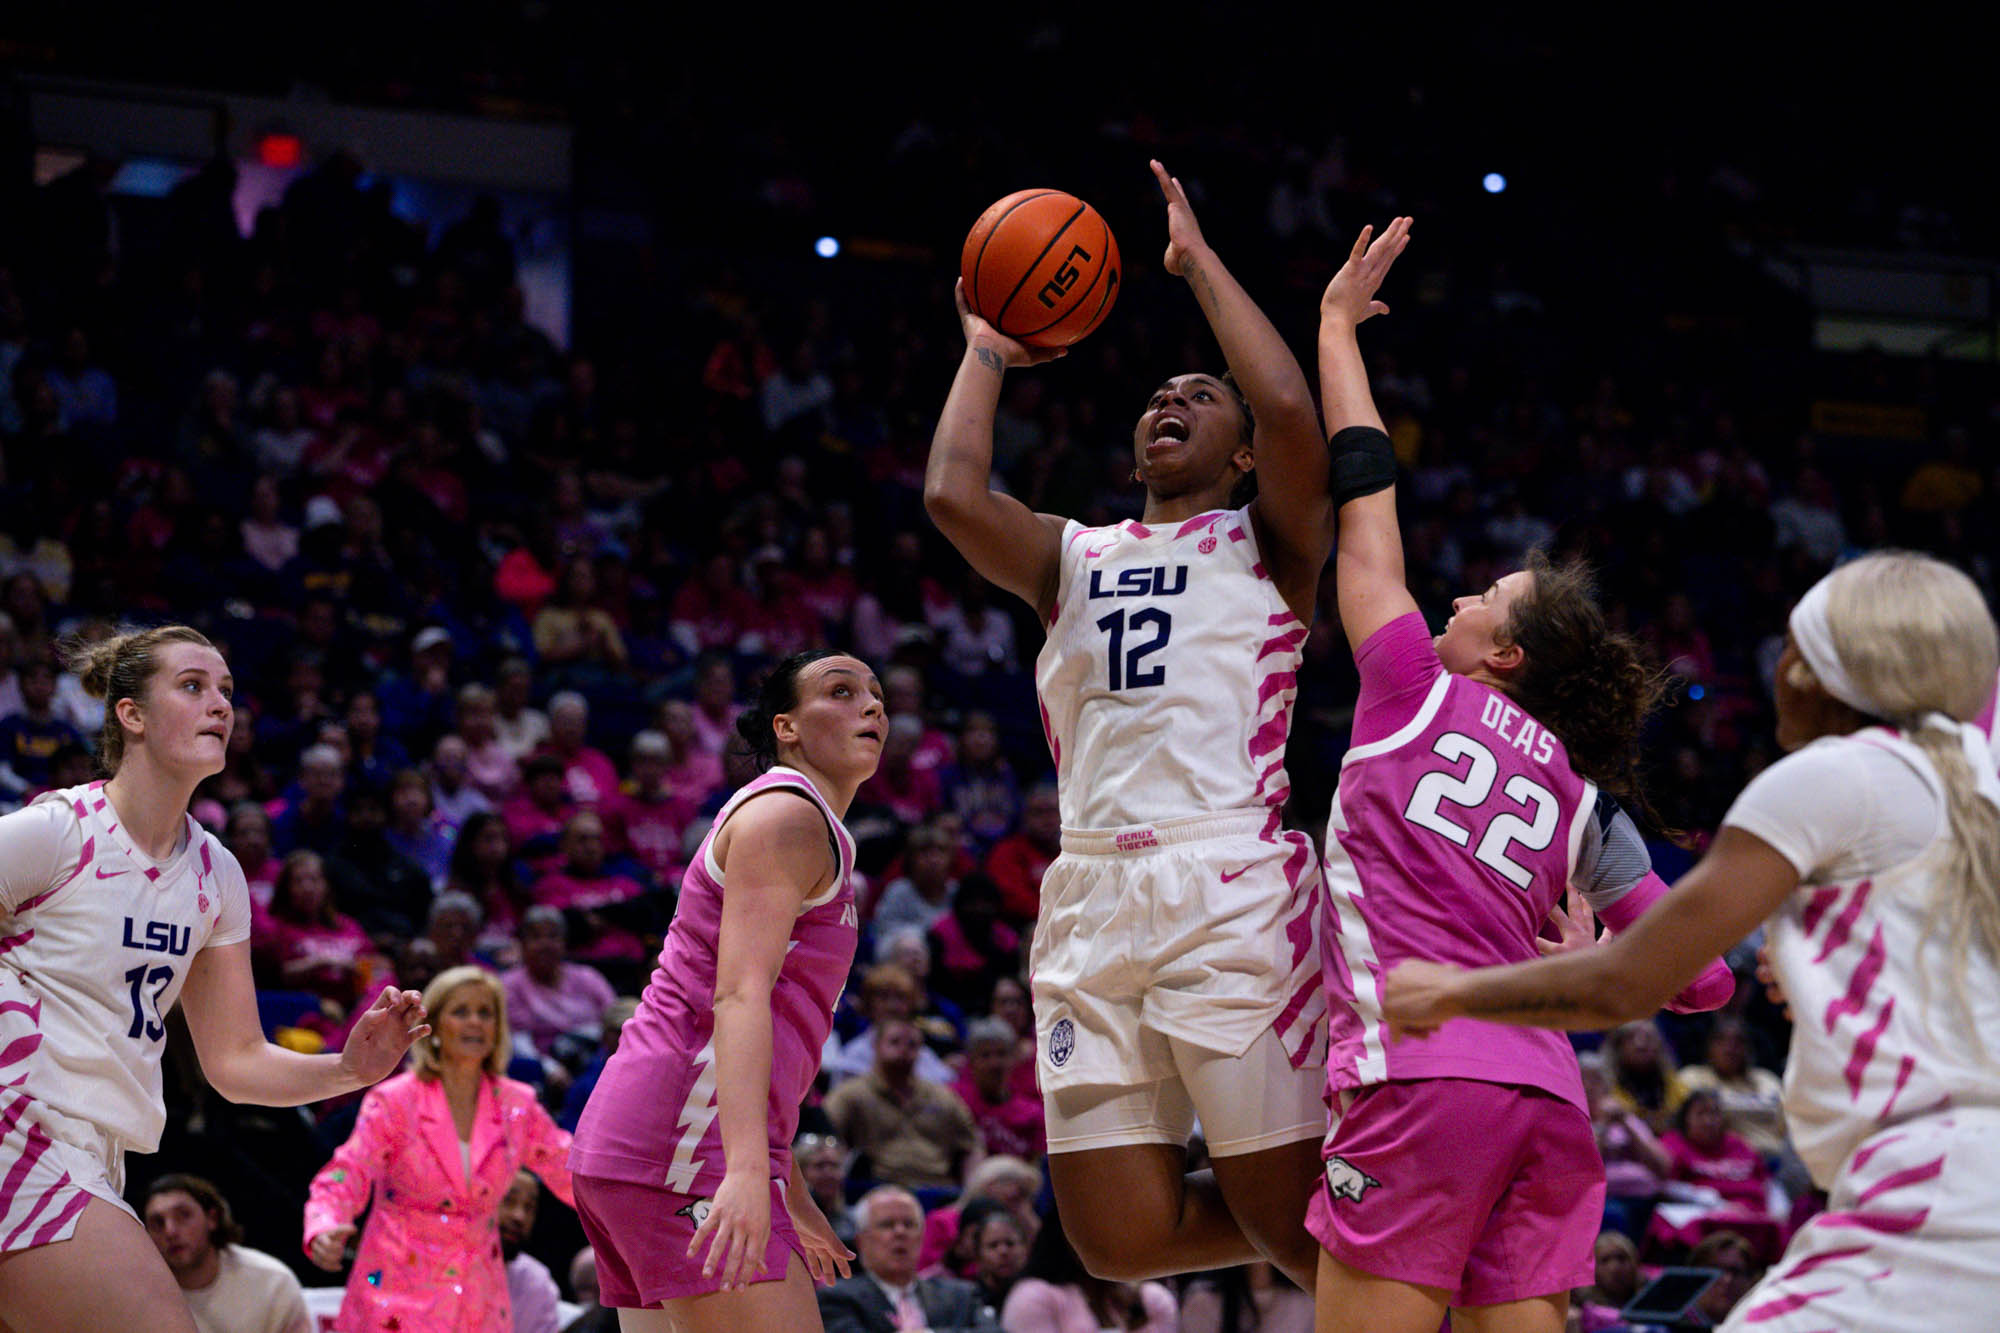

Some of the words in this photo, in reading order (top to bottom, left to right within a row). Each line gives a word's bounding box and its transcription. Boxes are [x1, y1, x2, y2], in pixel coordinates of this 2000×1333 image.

[1039, 245, 1091, 308] LSU
[1089, 565, 1188, 600] LSU
[1096, 607, 1171, 691] 12
[1480, 693, 1557, 765] DEAS
[1116, 830, 1153, 843] GEAUX
[1403, 731, 1561, 891] 22
[1116, 838, 1158, 851] TIGERS
[122, 916, 191, 956] LSU
[125, 963, 174, 1042] 13
